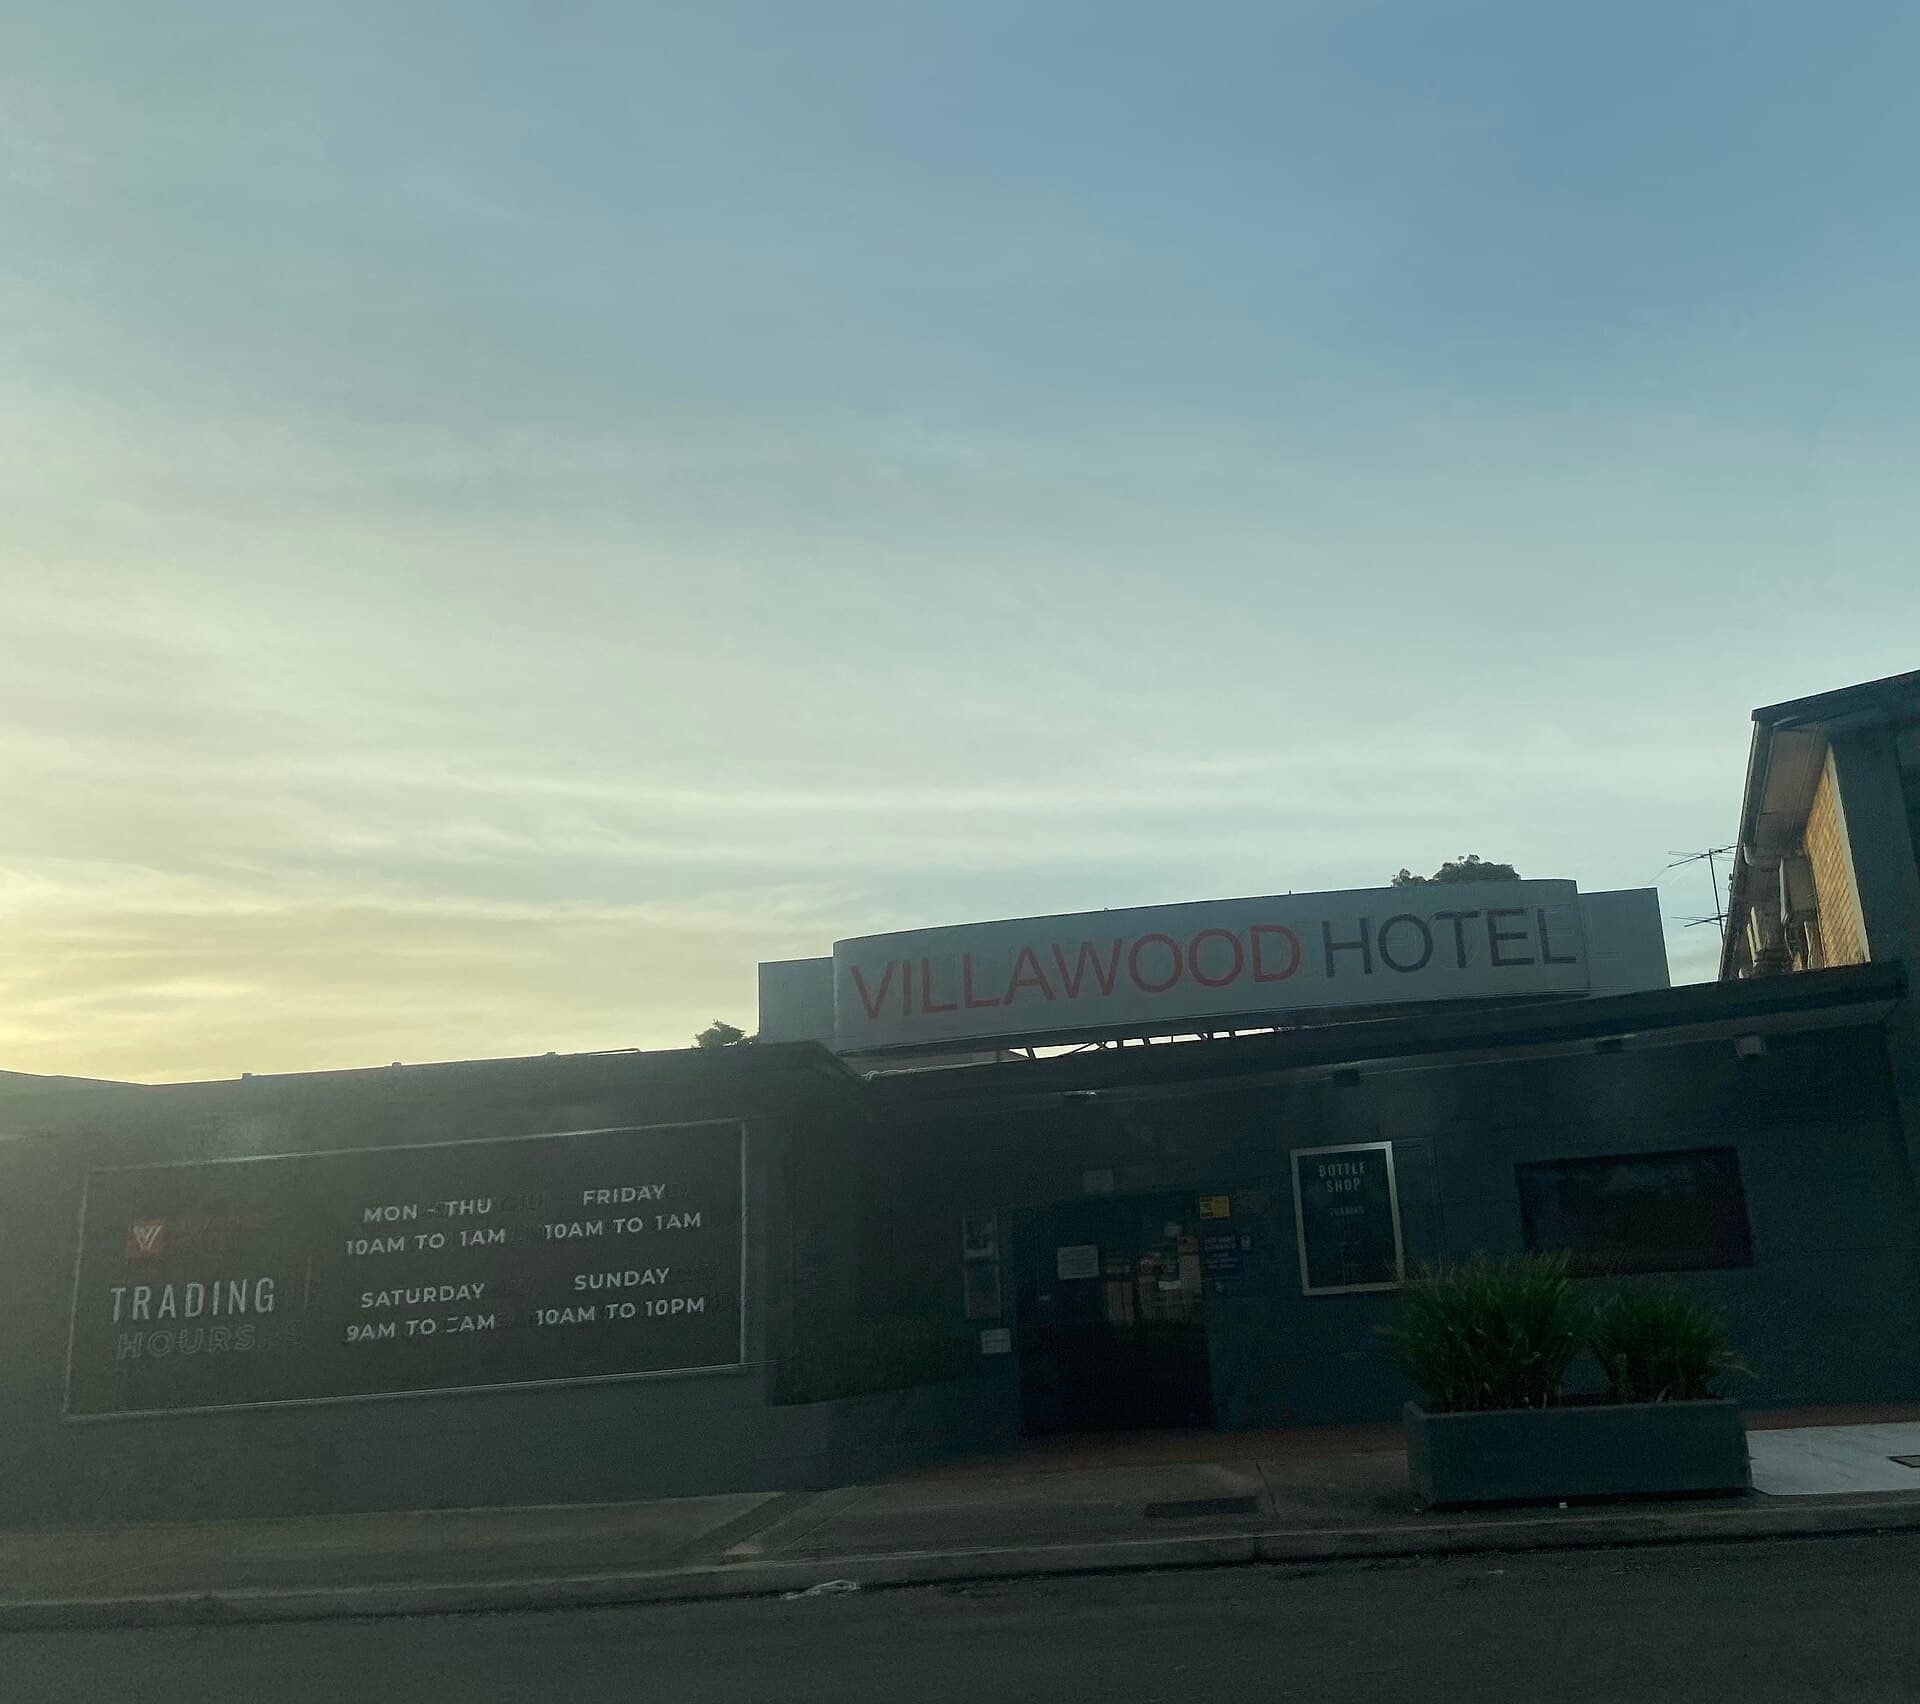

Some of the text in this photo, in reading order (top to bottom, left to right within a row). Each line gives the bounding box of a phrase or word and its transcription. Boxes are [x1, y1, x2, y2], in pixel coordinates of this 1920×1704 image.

[850, 907, 1577, 1019] VILLAWOOD HOTEL
[1319, 1161, 1366, 1178] BOTTLE
[582, 1183, 666, 1206] FRIDAY
[1326, 1177, 1360, 1193] SHOP
[363, 1204, 418, 1223] MON
[444, 1198, 493, 1217] THU
[544, 1212, 701, 1240] 10AM TO 1AM
[345, 1228, 506, 1256] 10AM TO 1AM
[573, 1267, 670, 1291] SUNDAY
[110, 1276, 276, 1323] TRADING
[360, 1282, 485, 1309] SATURDAY
[535, 1297, 705, 1326] 10AM TO 10PM
[115, 1323, 257, 1361] HOURS
[346, 1321, 396, 1342] 9AM
[405, 1318, 437, 1336] TO
